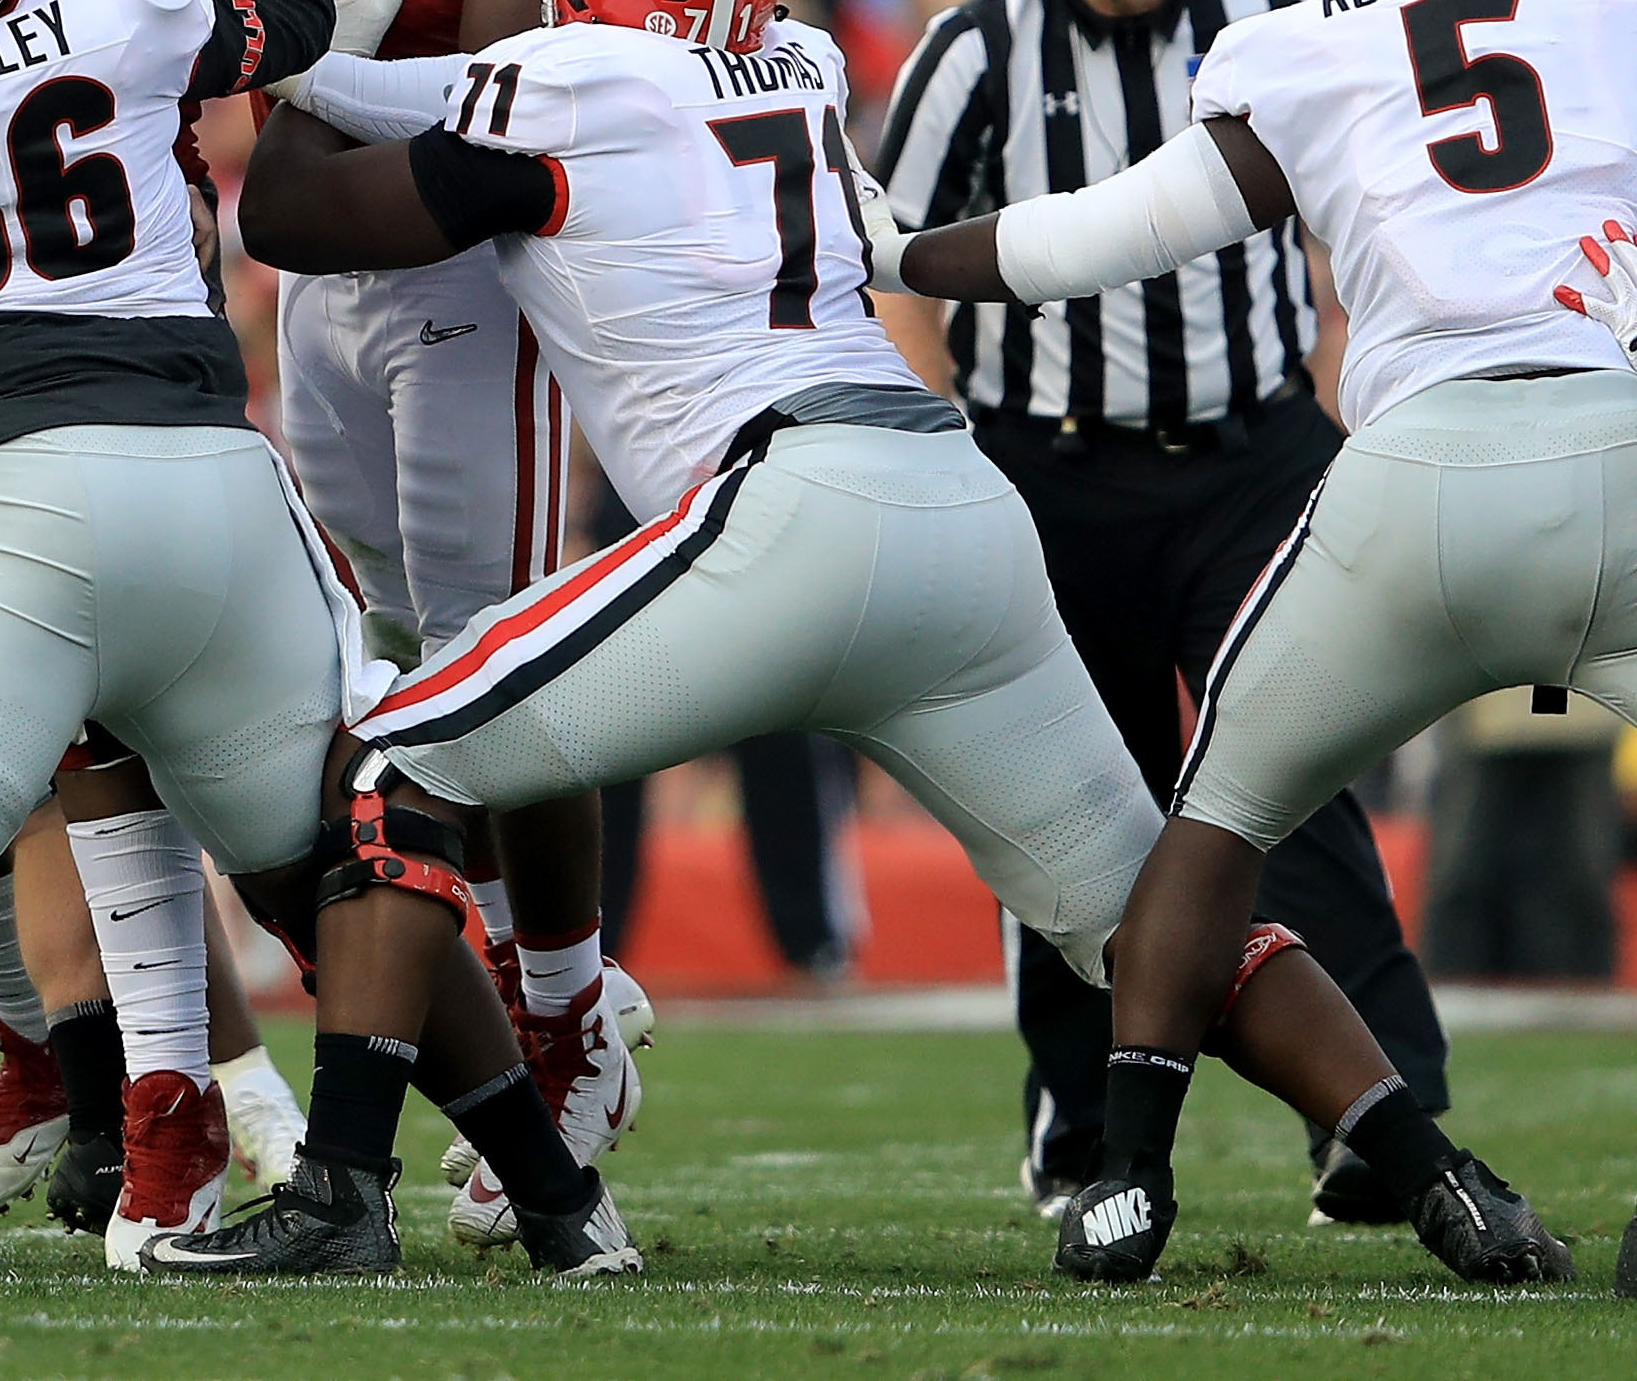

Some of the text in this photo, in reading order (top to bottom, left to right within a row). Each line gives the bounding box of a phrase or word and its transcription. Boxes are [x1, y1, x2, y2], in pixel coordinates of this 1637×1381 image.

[683, 4, 753, 43] 71
[456, 61, 524, 137] 71
[688, 41, 825, 100] THOMAS
[1149, 1055, 1190, 1074] GRIP
[1081, 1186, 1153, 1248] NIKE
